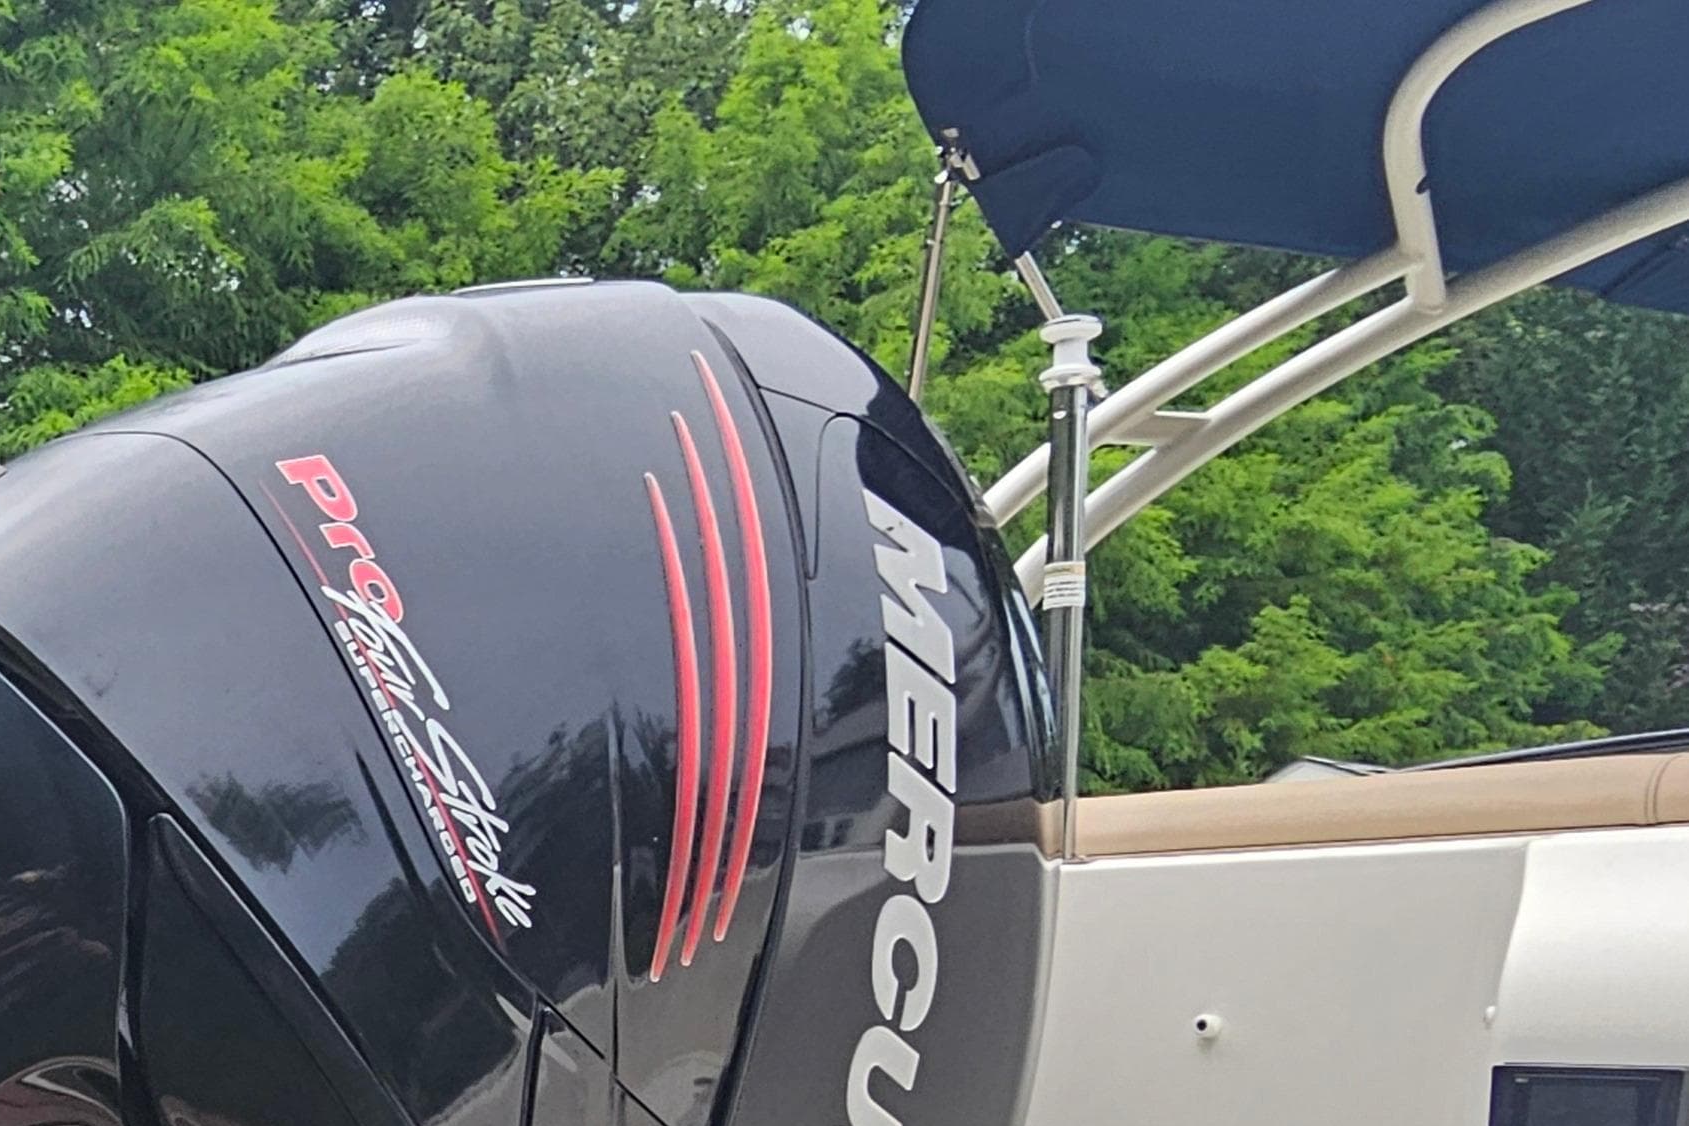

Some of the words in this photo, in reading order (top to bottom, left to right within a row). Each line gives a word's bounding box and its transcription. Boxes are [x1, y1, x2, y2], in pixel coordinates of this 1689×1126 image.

[276, 454, 404, 624] Pro
[320, 584, 450, 722] Four
[333, 620, 478, 904] SUPERCHARGED
[392, 709, 537, 929] Stroke
